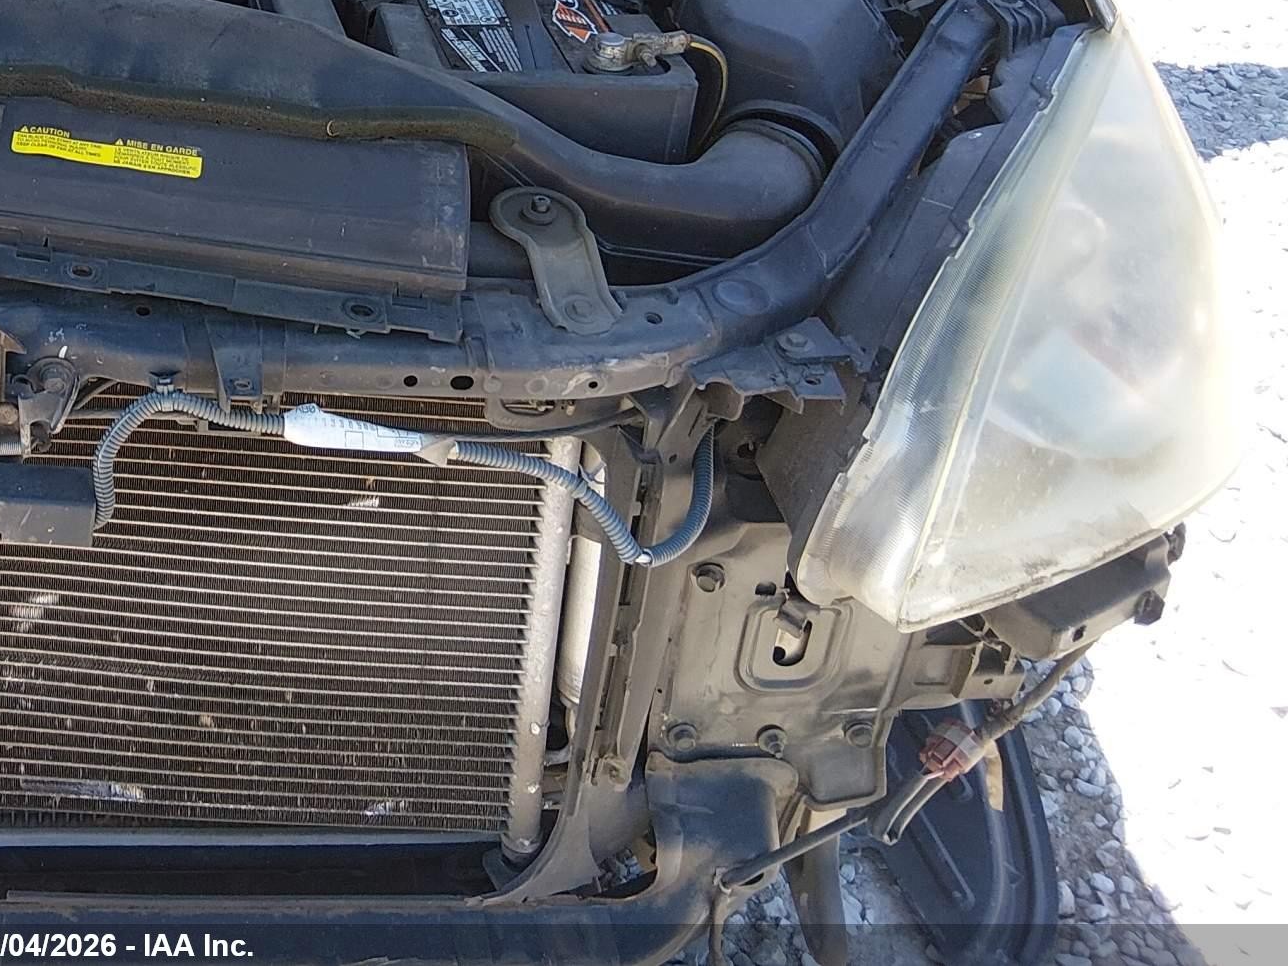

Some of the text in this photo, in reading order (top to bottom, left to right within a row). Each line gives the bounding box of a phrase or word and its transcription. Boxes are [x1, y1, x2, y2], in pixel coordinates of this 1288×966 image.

[30, 126, 71, 138] CAUTION
[126, 139, 199, 156] MISE EN GARDE
